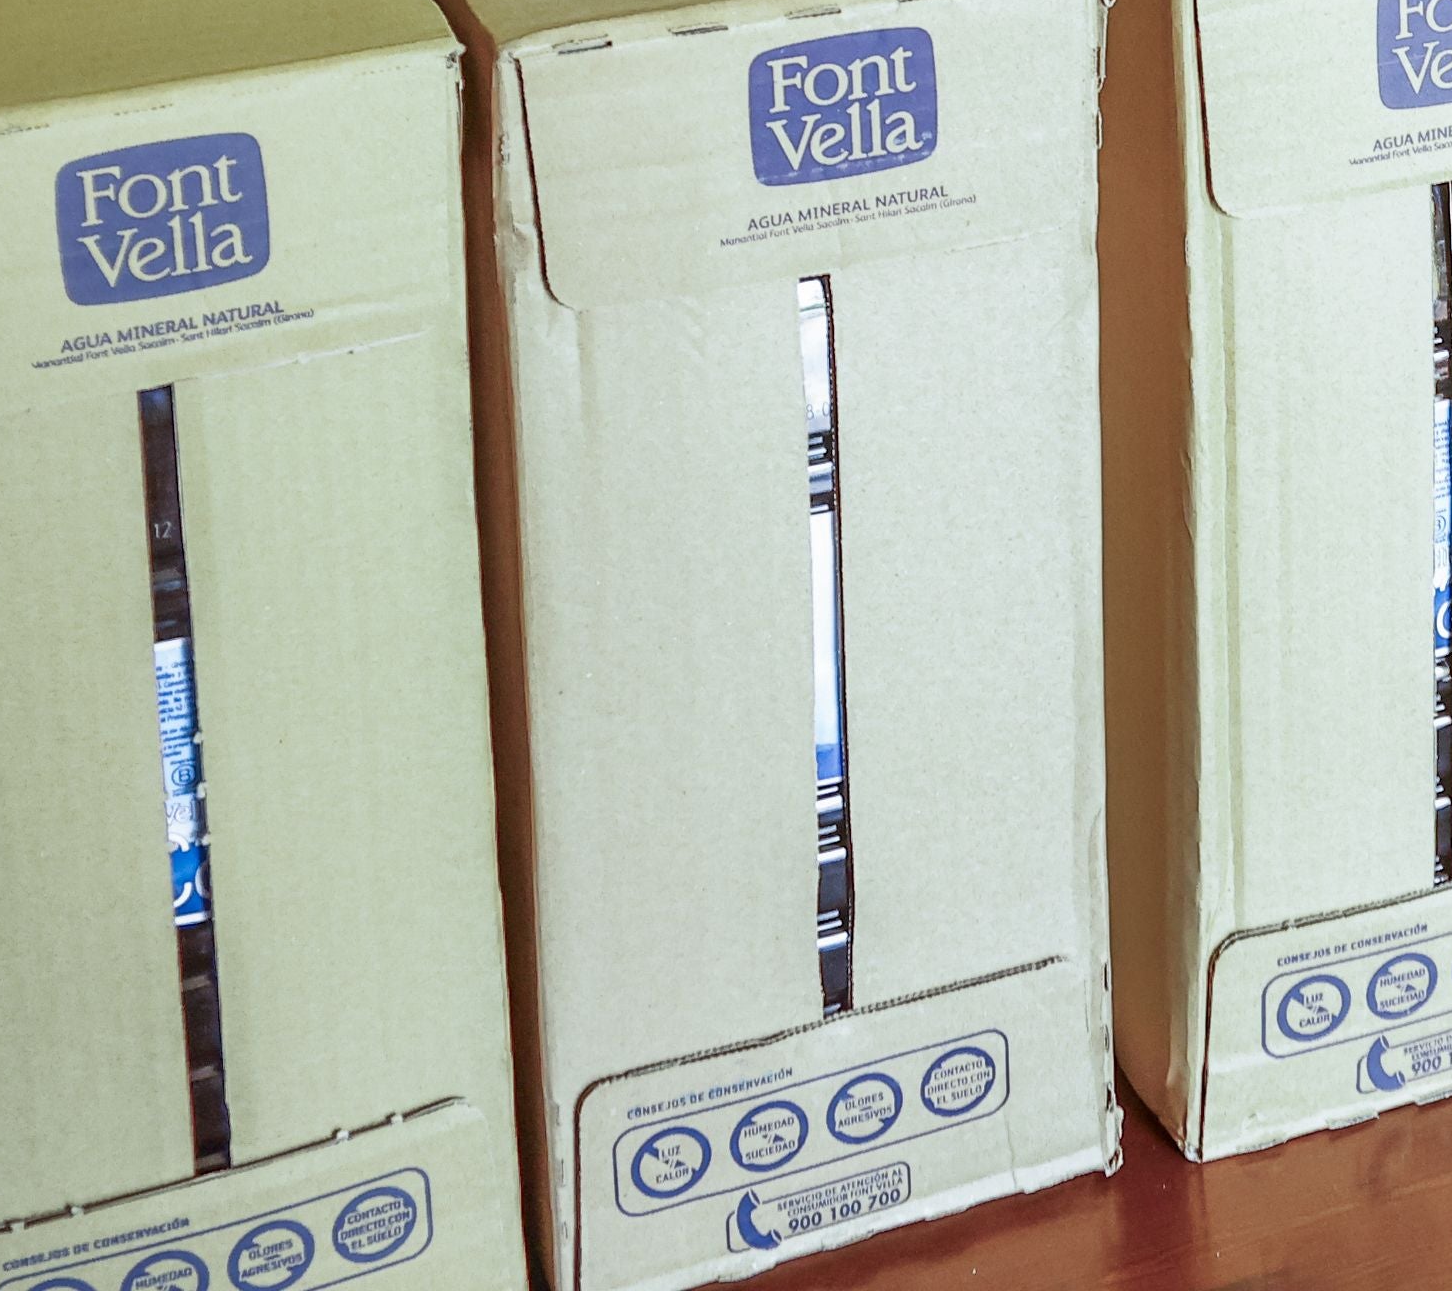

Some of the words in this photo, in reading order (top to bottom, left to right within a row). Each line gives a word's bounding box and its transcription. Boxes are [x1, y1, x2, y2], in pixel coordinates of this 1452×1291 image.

[766, 46, 917, 113] Font
[766, 99, 924, 171] Vella
[1372, 133, 1414, 151] AGUA
[76, 155, 243, 227] Font
[747, 212, 793, 231] AGUA
[798, 199, 869, 221] MINERAL
[874, 185, 947, 208] NATURAL
[77, 212, 252, 288] Vella
[60, 332, 112, 353] AGUA
[117, 317, 197, 342] MINERAL
[202, 301, 284, 326] NATURAL
[1276, 947, 1330, 966] CONSEJOS
[1333, 943, 1347, 954] DE
[934, 1060, 983, 1080] CONTACTO
[1411, 1056, 1441, 1076] 900
[626, 1096, 686, 1119] CONSEJOS
[689, 1092, 704, 1104] DE
[707, 1067, 792, 1099] CONSERVACIÓN
[927, 1078, 968, 1096] DIRECTO
[970, 1070, 990, 1083] CON
[845, 1092, 884, 1111] OLORES
[936, 1094, 948, 1105] EL
[951, 1085, 983, 1101] SUELO
[743, 1117, 795, 1138] HUMEDAD
[838, 1106, 892, 1128] AGRESIVOS
[661, 1145, 681, 1159] LUZ
[745, 1140, 796, 1160] SUCIEDAD
[656, 1167, 689, 1184] CALOR
[777, 1192, 823, 1211] SERVICIO
[825, 1187, 836, 1197] DE
[850, 1186, 874, 1199] FONT
[876, 1177, 903, 1191] VELLA
[347, 1201, 401, 1225] CONTACTO
[789, 1212, 822, 1232] 900
[831, 1200, 861, 1220] 100
[869, 1189, 900, 1210] 700
[72, 1242, 89, 1255] DE
[93, 1217, 189, 1249] CONSERVACIÓN
[340, 1220, 385, 1242] DIRECTO
[387, 1210, 410, 1226] CON
[249, 1239, 293, 1260] OLORES
[351, 1240, 364, 1250] EL
[367, 1227, 402, 1246] SUELO
[242, 1254, 303, 1278] AGRESIVOS
[136, 1268, 192, 1290] HUMEDAD
